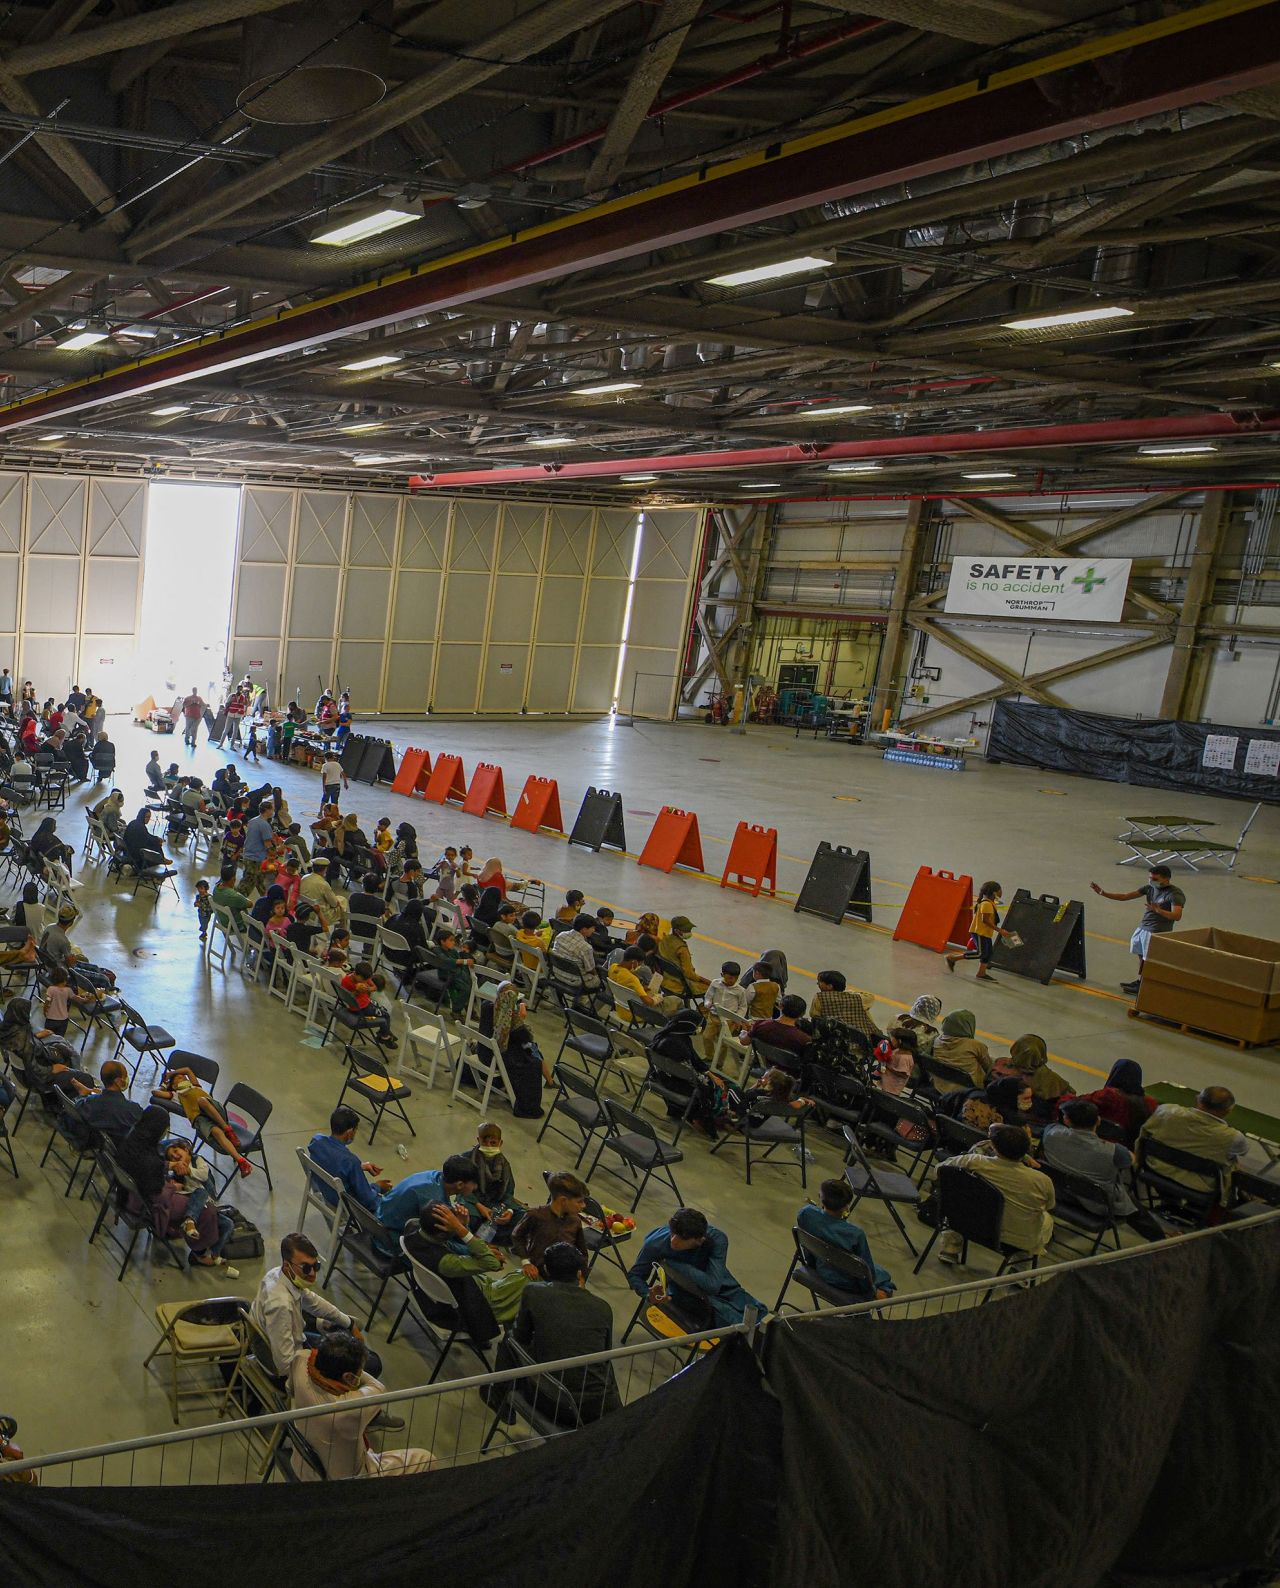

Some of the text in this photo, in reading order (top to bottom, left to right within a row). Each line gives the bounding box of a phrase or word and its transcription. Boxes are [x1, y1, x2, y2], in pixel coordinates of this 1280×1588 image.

[970, 563, 1068, 580] SAFETY
[966, 580, 1065, 594] is no accident
